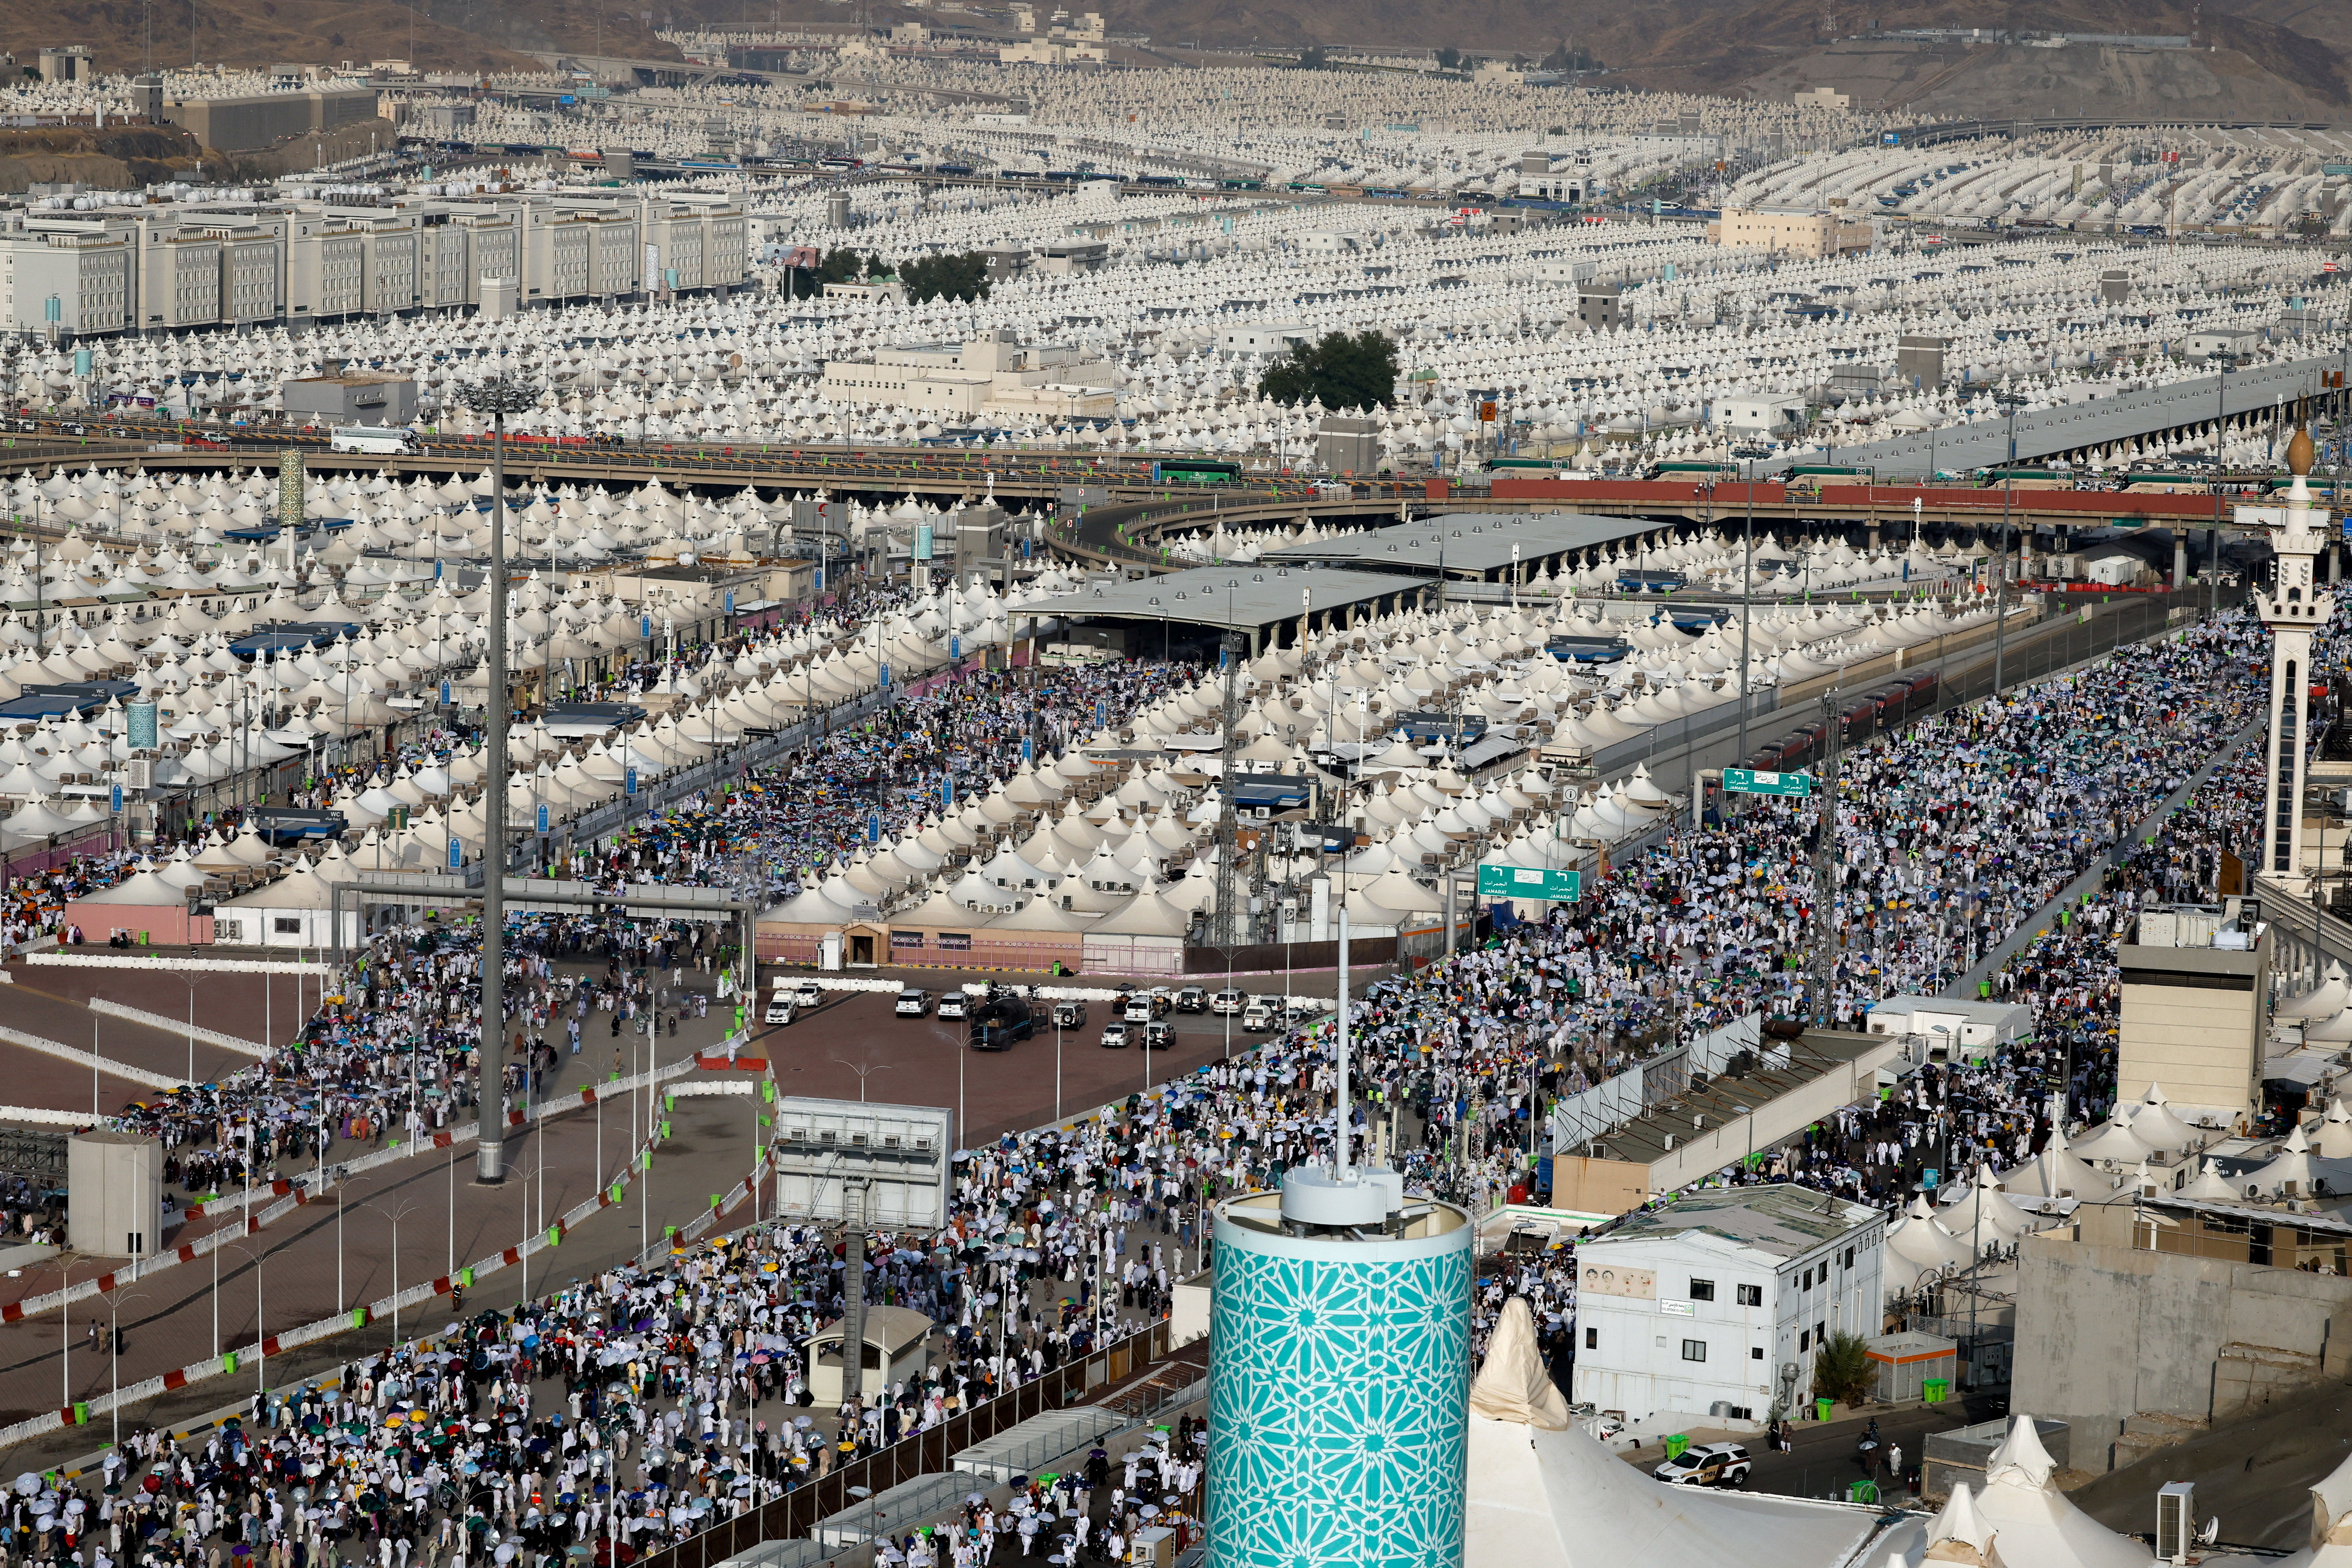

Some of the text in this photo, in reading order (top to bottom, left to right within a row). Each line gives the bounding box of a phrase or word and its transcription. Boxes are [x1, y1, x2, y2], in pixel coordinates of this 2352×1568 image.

[412, 219, 416, 227] E
[274, 226, 278, 234] C
[124, 233, 129, 242] A
[154, 233, 158, 242] B
[986, 257, 996, 266] 22
[1486, 407, 1492, 415] 2
[392, 809, 403, 830] i
